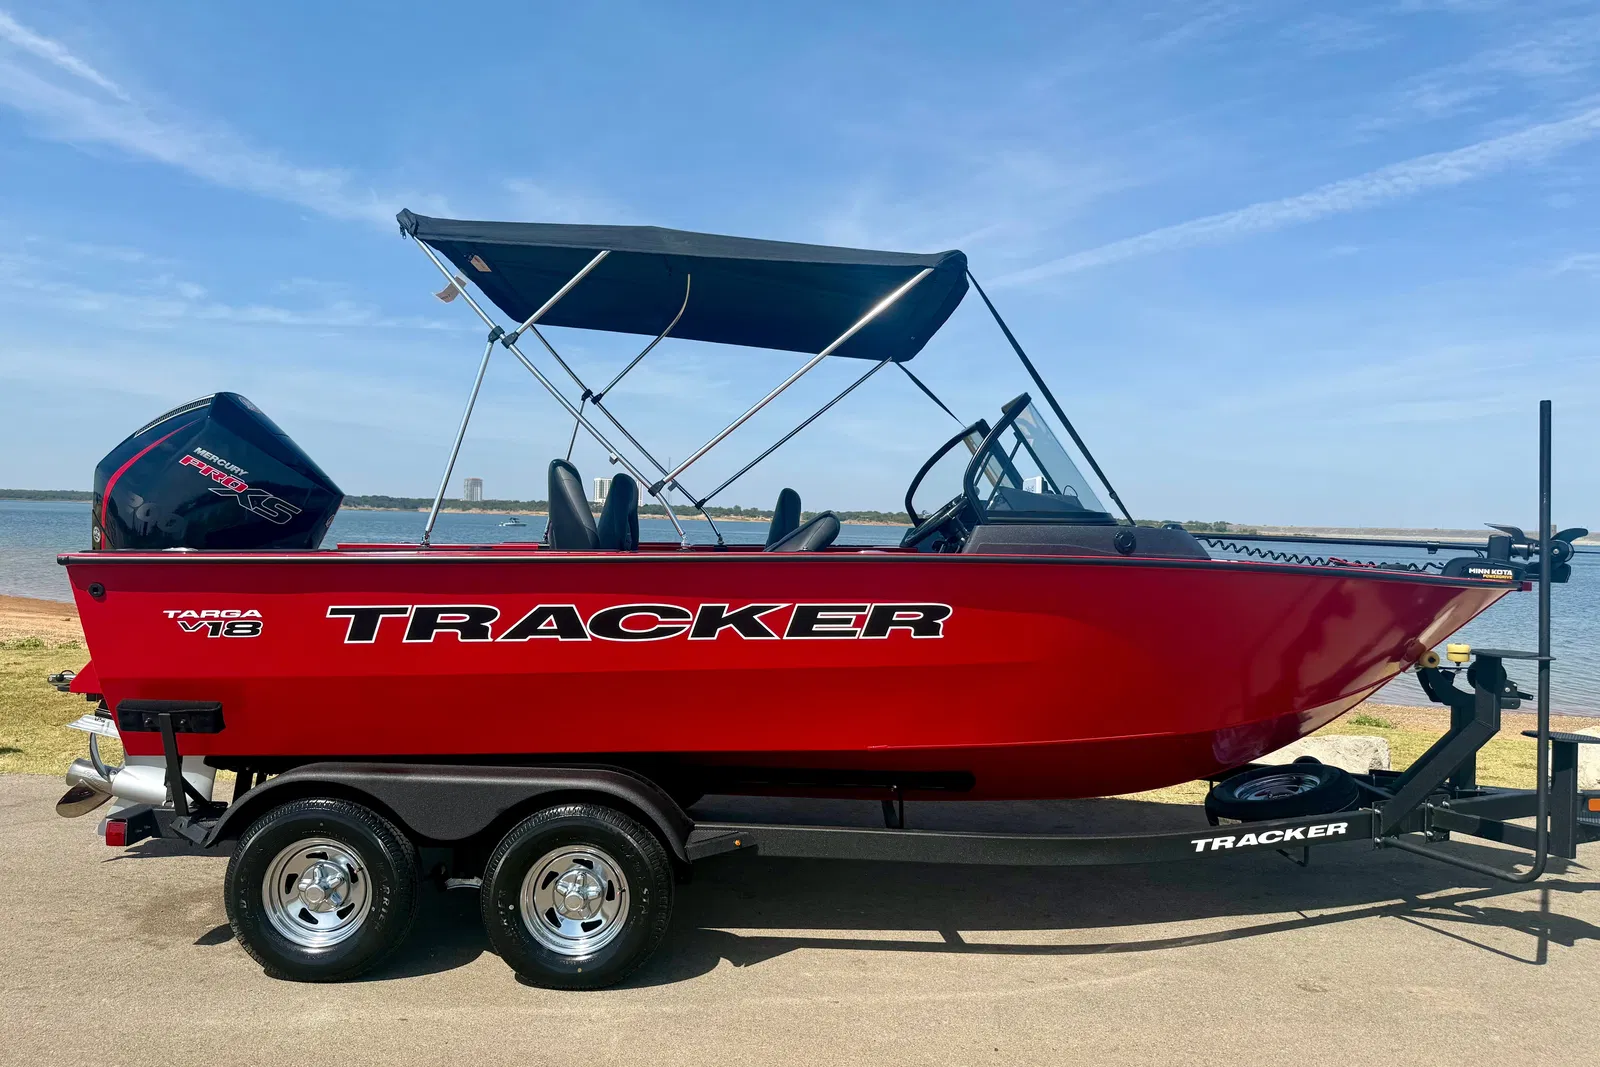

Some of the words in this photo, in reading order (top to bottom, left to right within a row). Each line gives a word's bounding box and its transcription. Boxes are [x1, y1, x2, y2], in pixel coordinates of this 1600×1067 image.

[179, 454, 249, 493] PRO
[193, 447, 249, 476] MERCURY
[208, 474, 302, 525] XS
[163, 610, 262, 618] TARGA
[177, 620, 263, 638] V18
[326, 603, 953, 643] TRACKER
[1191, 822, 1348, 852] TRACKER
